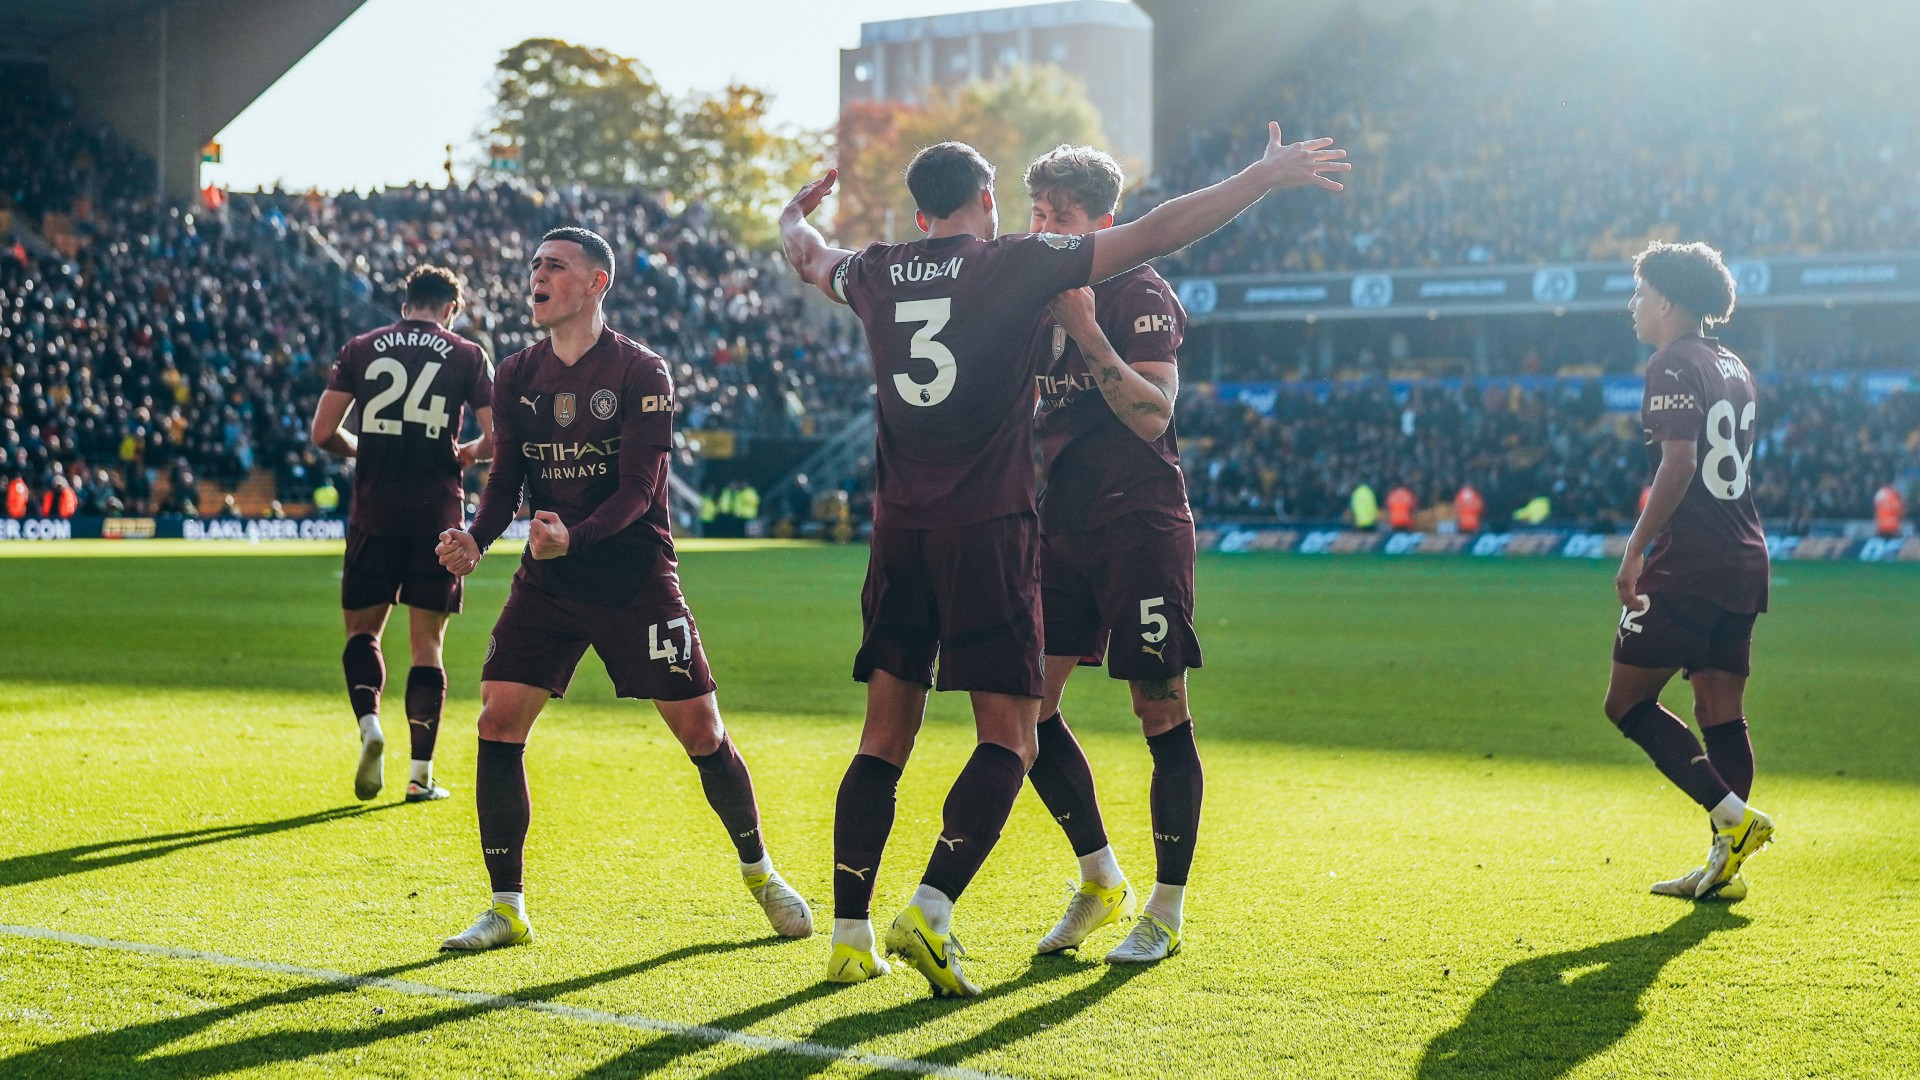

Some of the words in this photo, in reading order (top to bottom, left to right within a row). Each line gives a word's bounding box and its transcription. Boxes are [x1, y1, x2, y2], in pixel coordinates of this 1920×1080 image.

[890, 256, 963, 286] RÚBEN
[1134, 314, 1177, 334] OKX
[373, 332, 453, 359] GVARDIOL
[893, 298, 957, 407] 3
[362, 357, 449, 439] 24
[1650, 394, 1694, 411] OKX
[541, 462, 607, 479] AIRWAYS
[1140, 596, 1168, 643] 5
[1619, 594, 1651, 634] 2
[649, 616, 691, 664] 47
